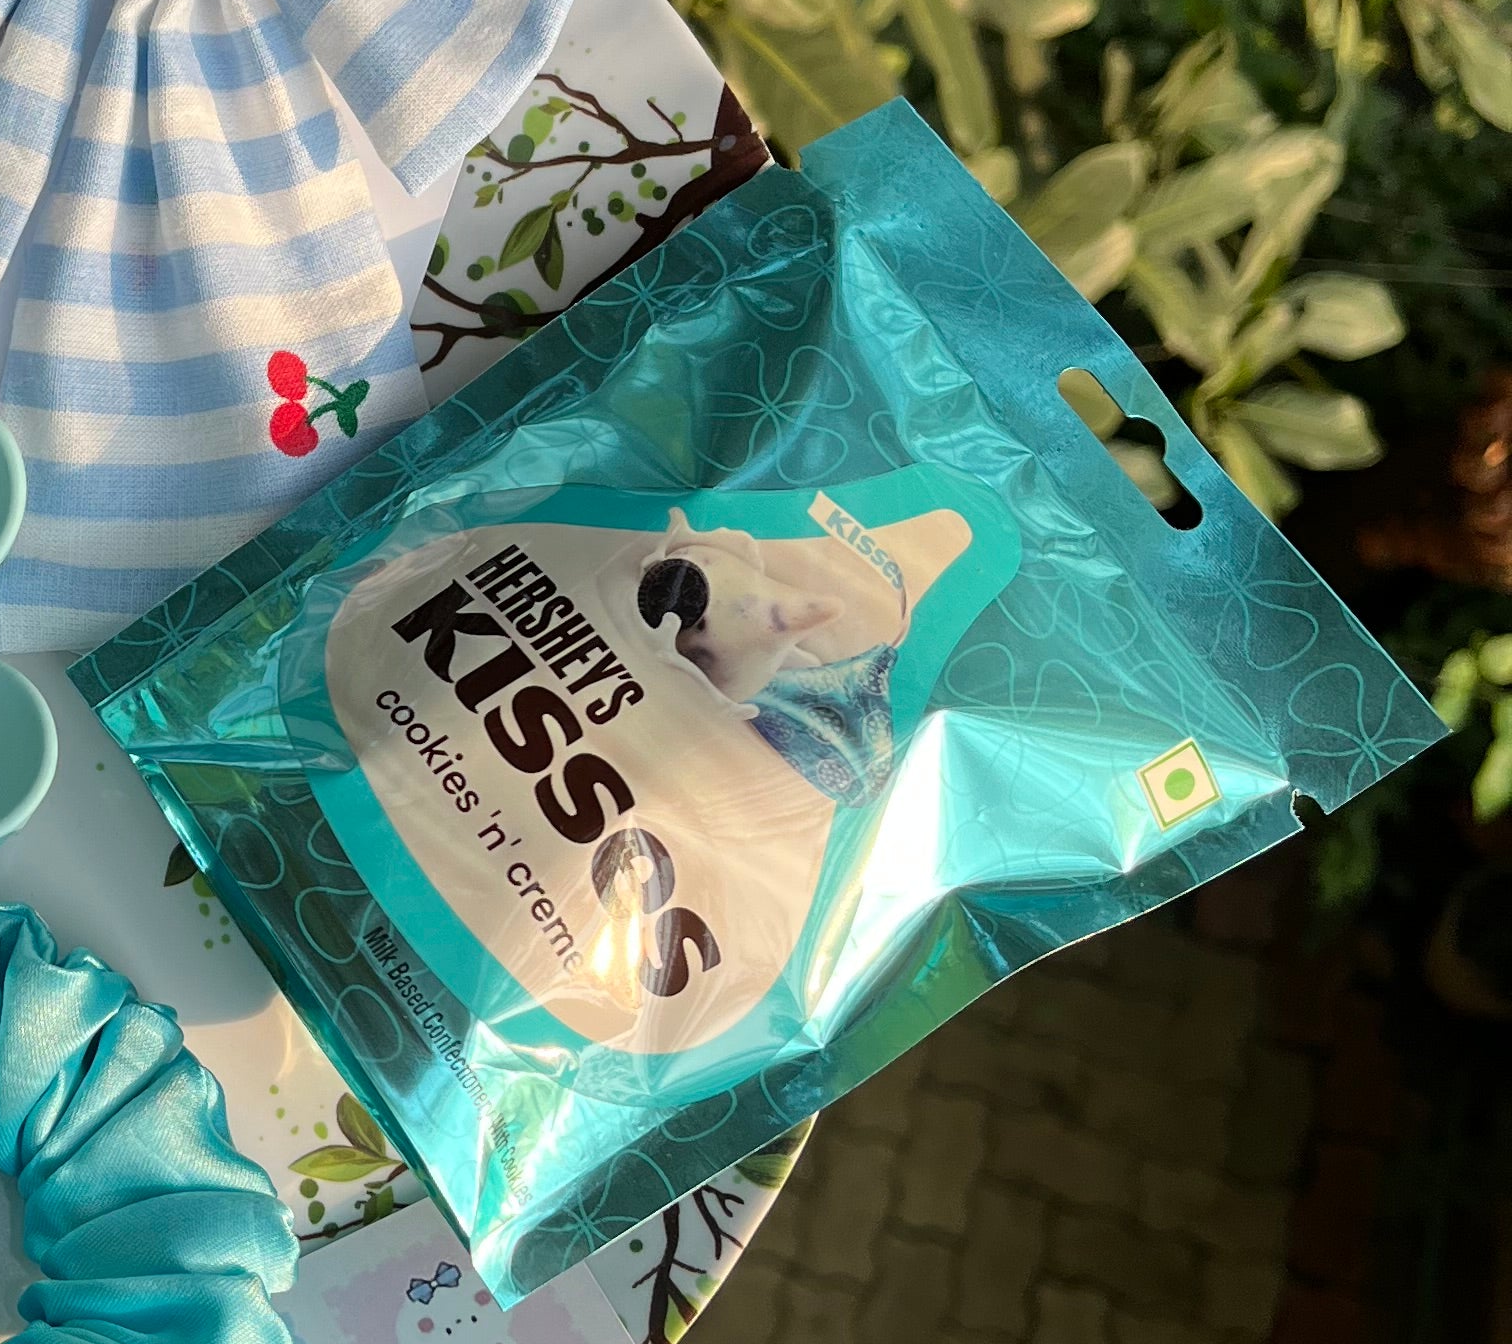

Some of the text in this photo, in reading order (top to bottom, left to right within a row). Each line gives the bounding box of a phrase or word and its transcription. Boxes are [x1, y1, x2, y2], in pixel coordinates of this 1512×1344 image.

[464, 544, 645, 725] HERSHEY'S
[376, 690, 583, 975] cookies 'n' creme
[362, 926, 398, 967] Milk
[388, 962, 435, 1016] Based
